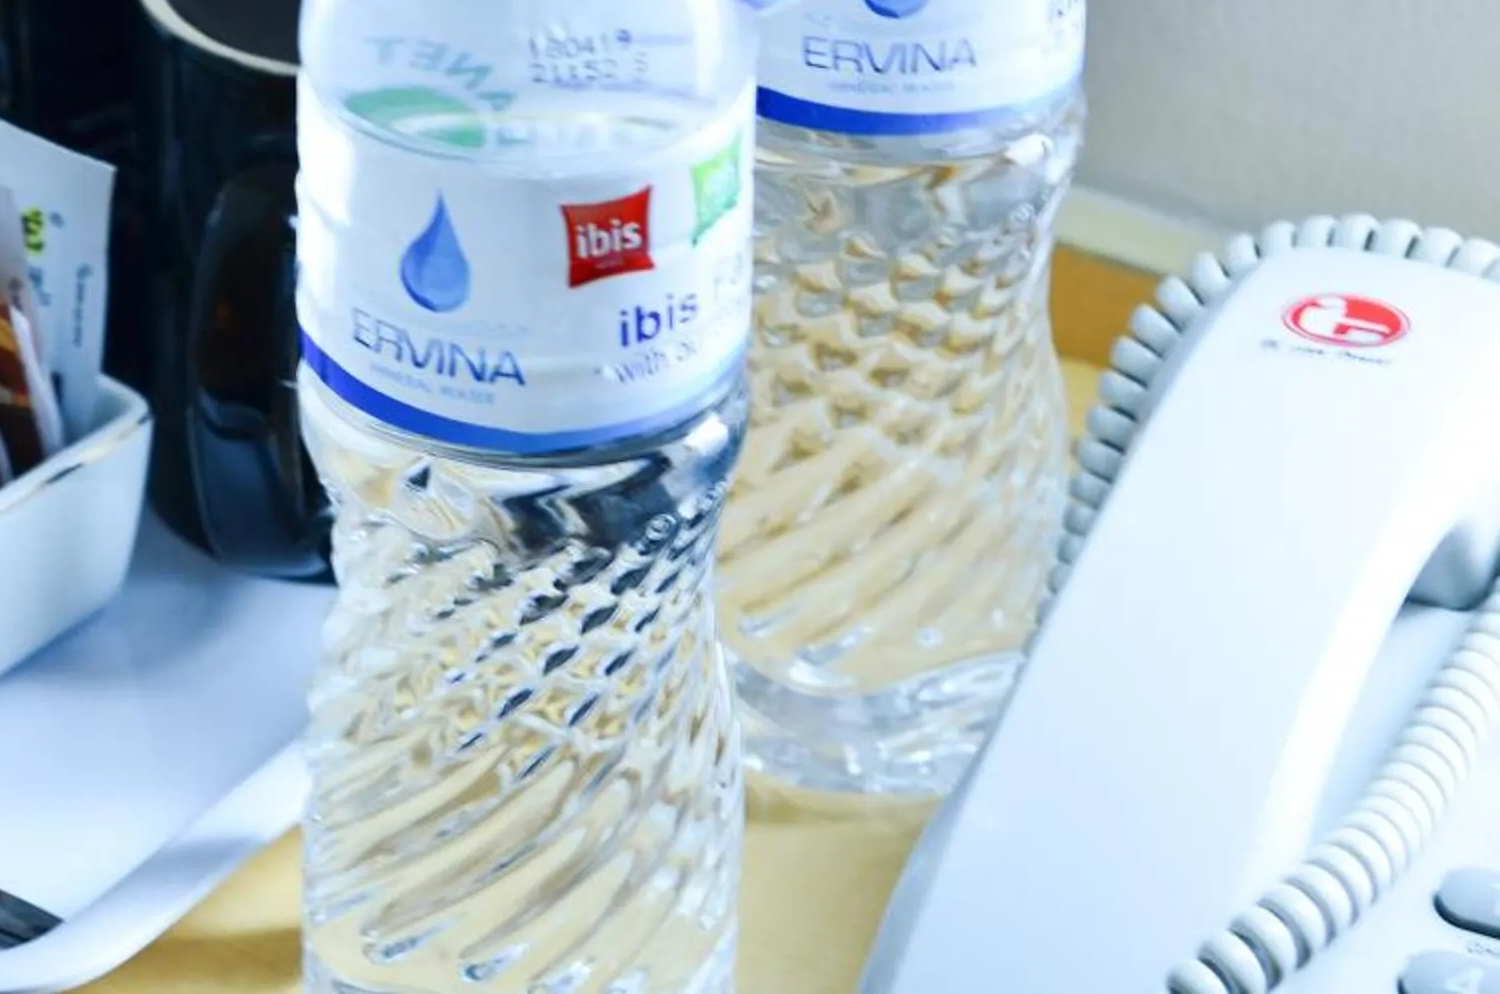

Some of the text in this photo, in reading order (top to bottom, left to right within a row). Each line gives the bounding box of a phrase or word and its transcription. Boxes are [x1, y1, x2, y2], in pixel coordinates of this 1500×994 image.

[802, 35, 980, 75] ERVINA
[575, 218, 643, 258] ibis
[619, 293, 698, 348] ibis
[352, 305, 528, 387] ERVINA
